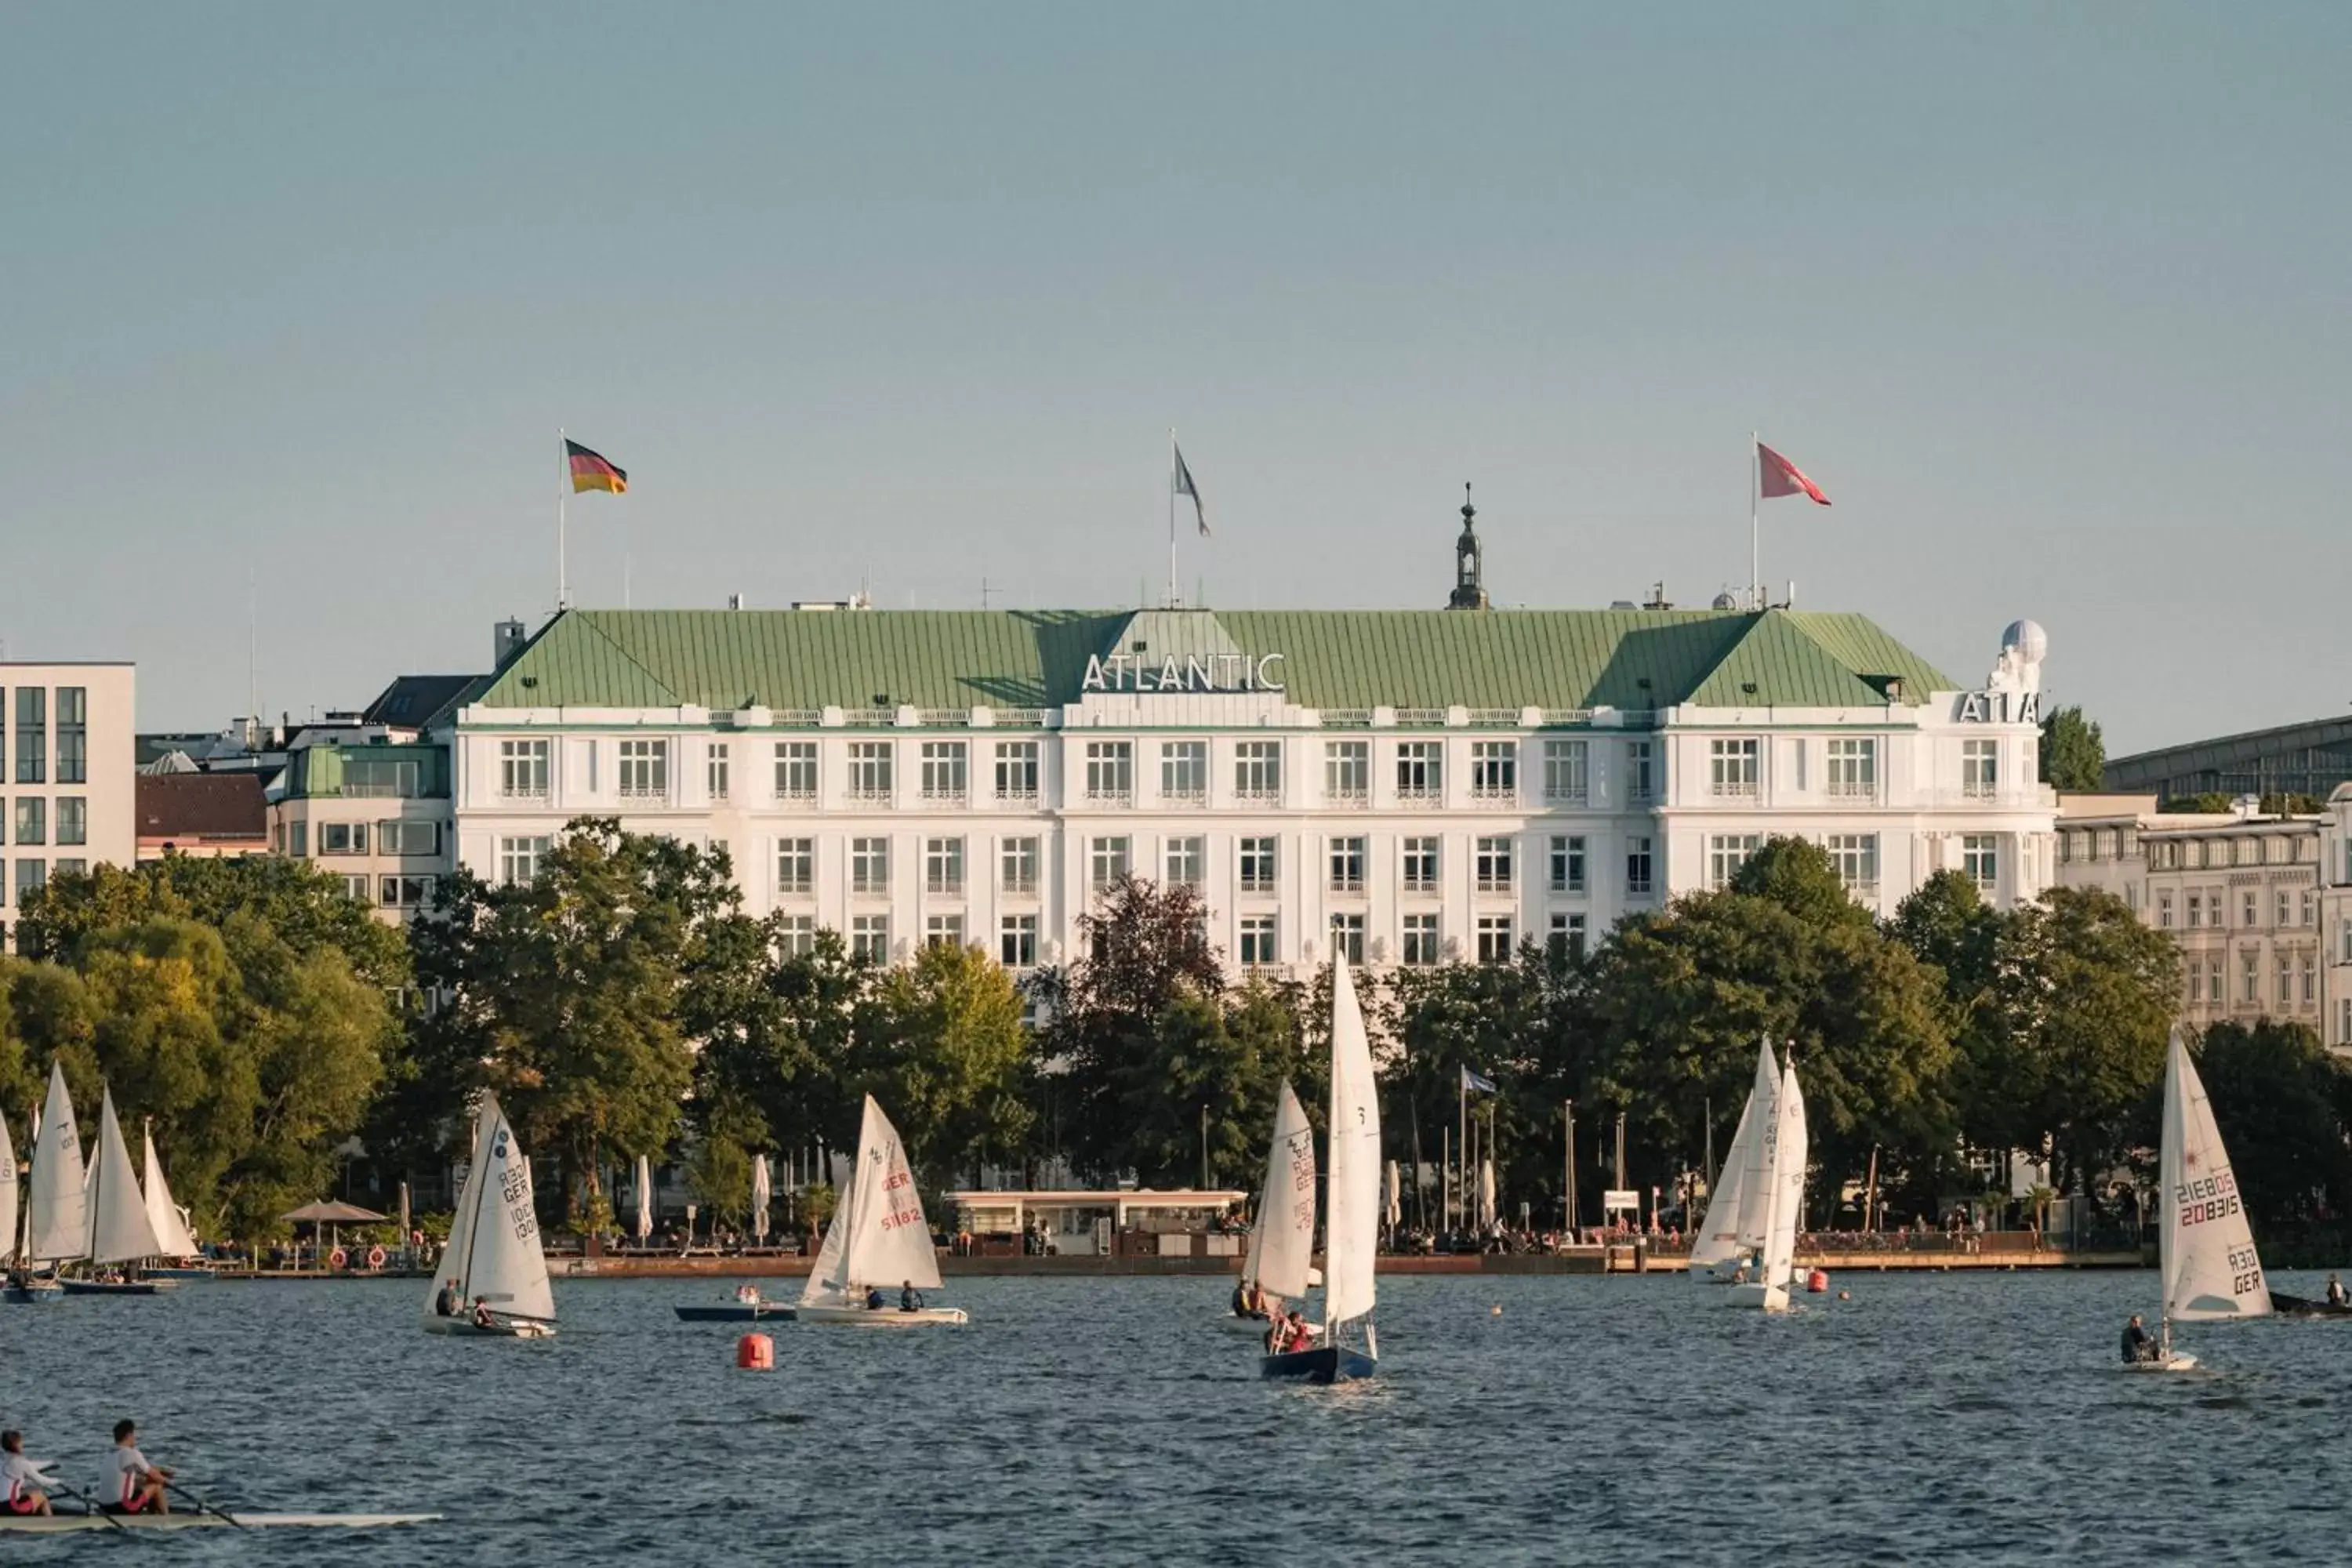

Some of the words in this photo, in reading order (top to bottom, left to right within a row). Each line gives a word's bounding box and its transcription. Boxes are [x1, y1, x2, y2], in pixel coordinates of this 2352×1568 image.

[1082, 654, 1285, 690] ATLANTIC
[1959, 691, 2042, 722] ATLA
[504, 1179, 529, 1203] GER
[2181, 1196, 2238, 1226] 208315
[2234, 1271, 2260, 1294] GER
